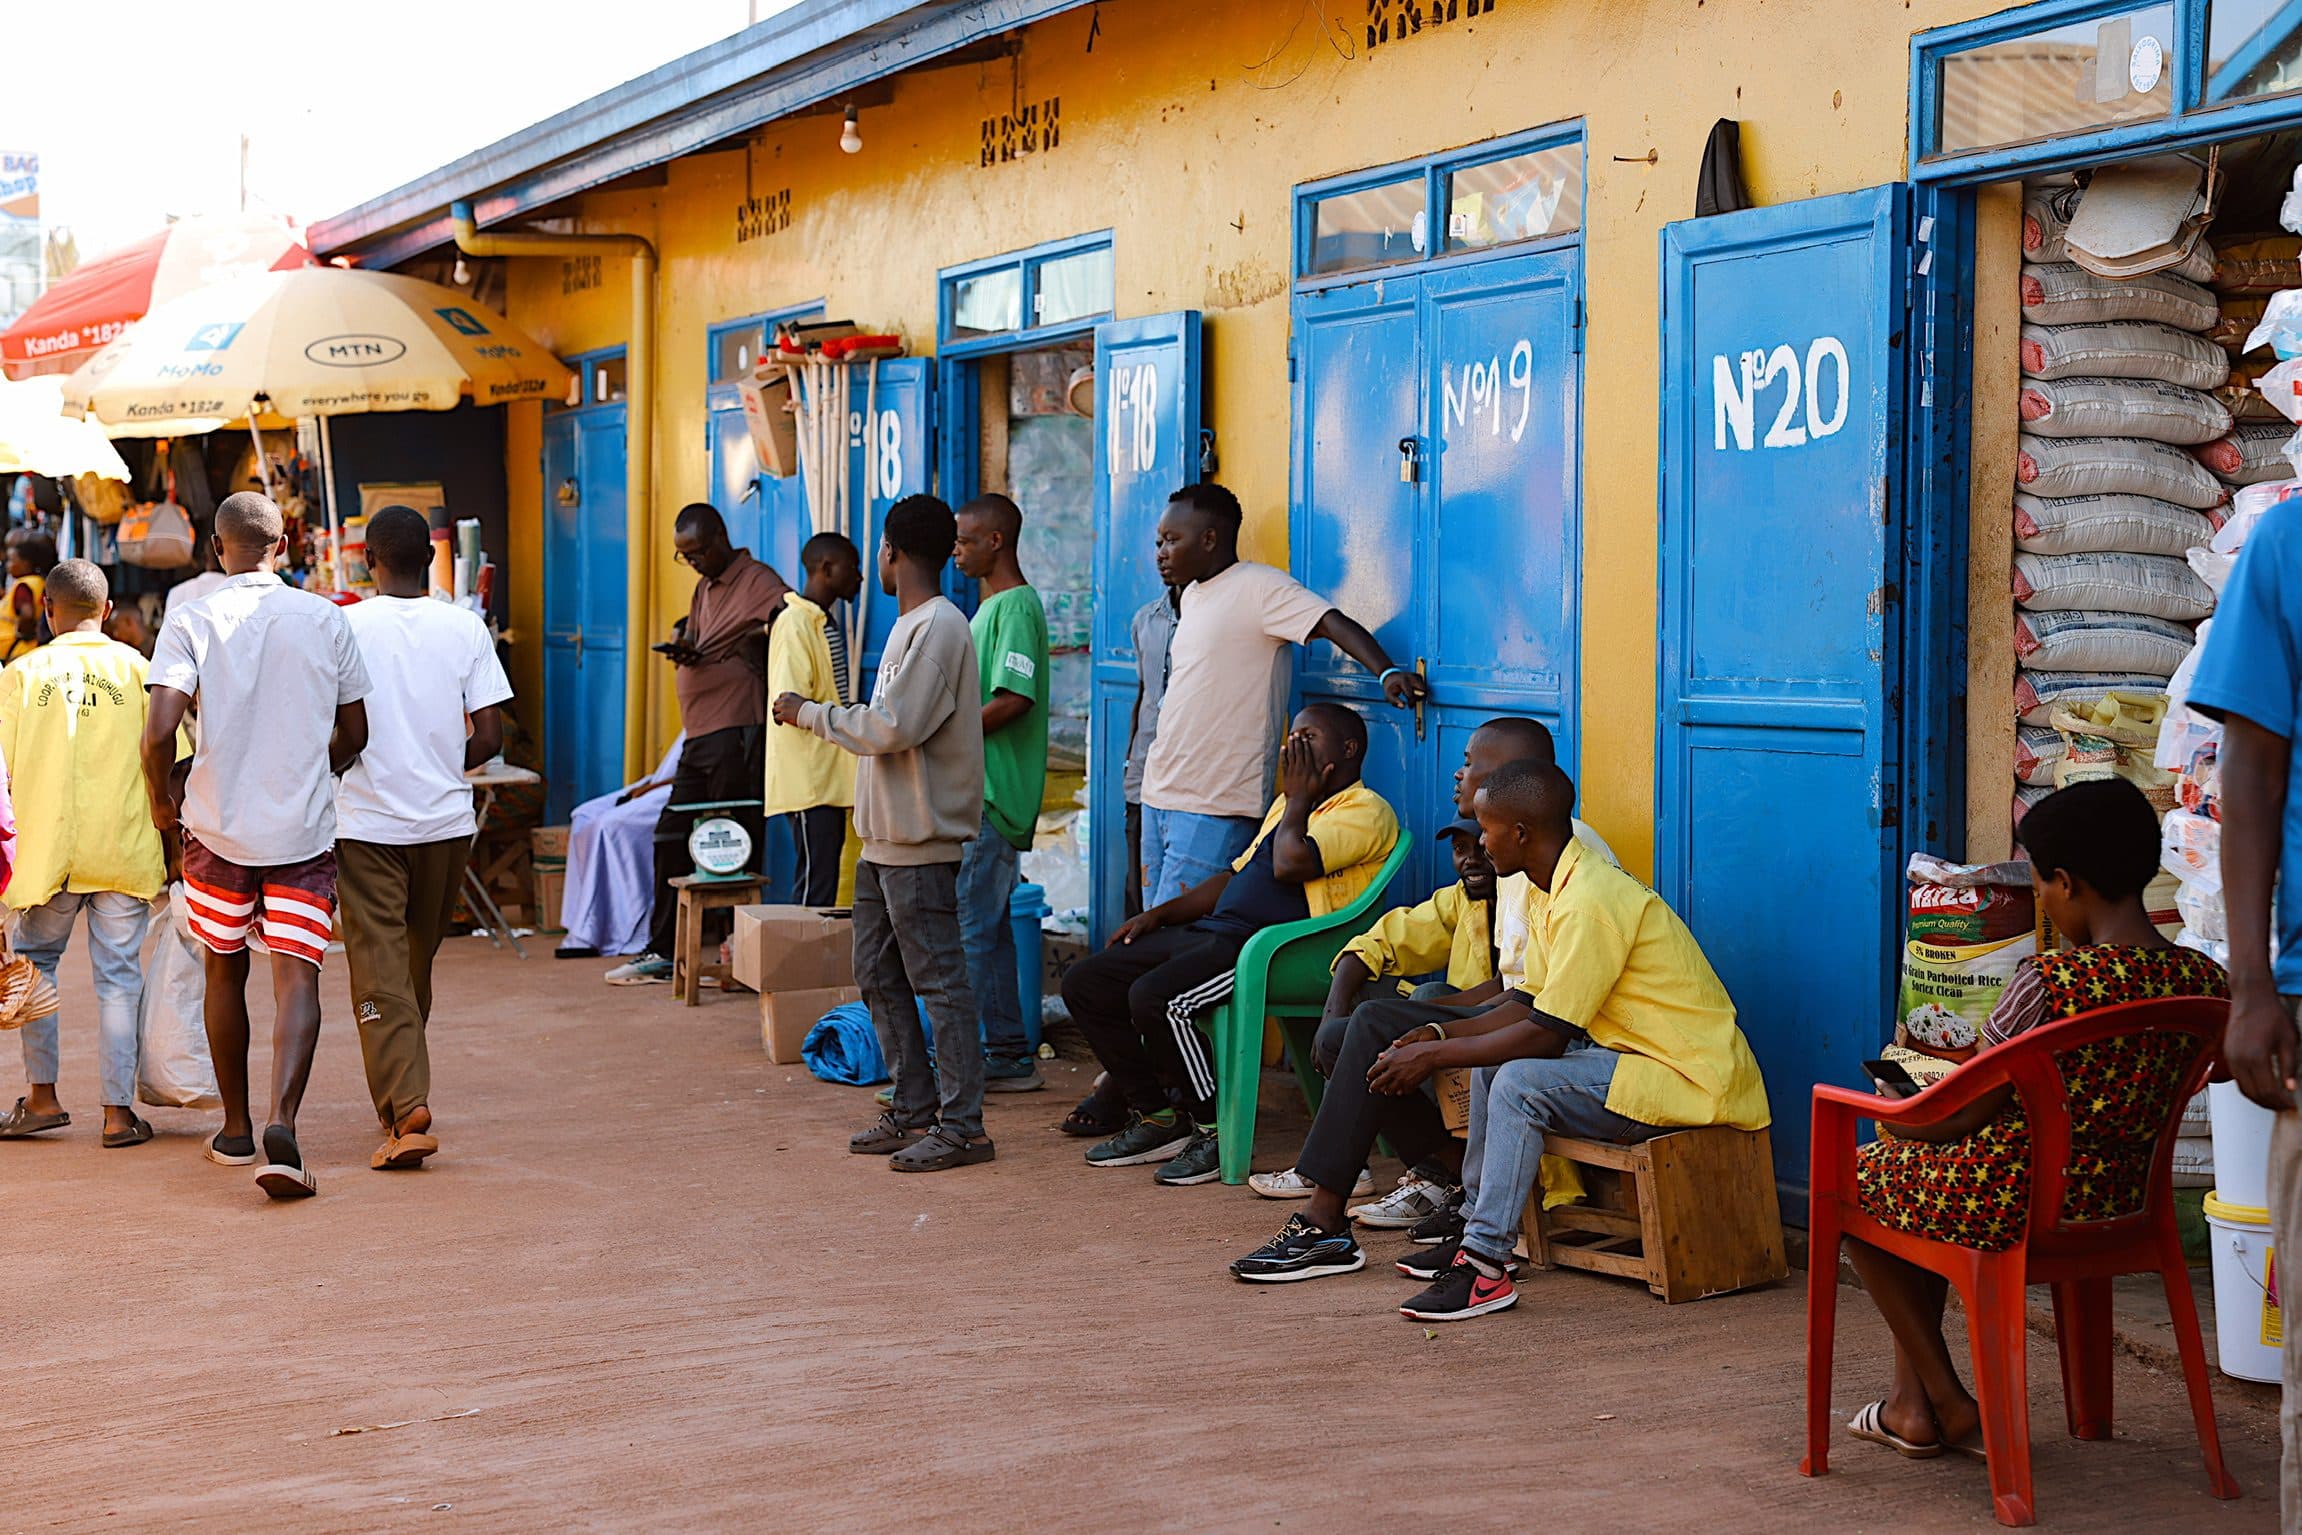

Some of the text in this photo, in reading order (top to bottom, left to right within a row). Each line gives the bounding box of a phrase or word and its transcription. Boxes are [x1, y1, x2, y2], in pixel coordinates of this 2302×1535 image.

[3, 154, 39, 173] BAG
[24, 329, 80, 358] Kanda
[328, 343, 382, 357] MTN
[302, 391, 431, 406] everywhere you go
[126, 401, 175, 417] Kanda
[1938, 919, 1969, 931] Quality
[1925, 948, 1957, 961] BROKEN
[1909, 964, 1925, 980] Grain
[1927, 970, 1974, 986] Parboiled
[1978, 974, 2003, 988] Rice
[1936, 984, 1963, 999] Clean
